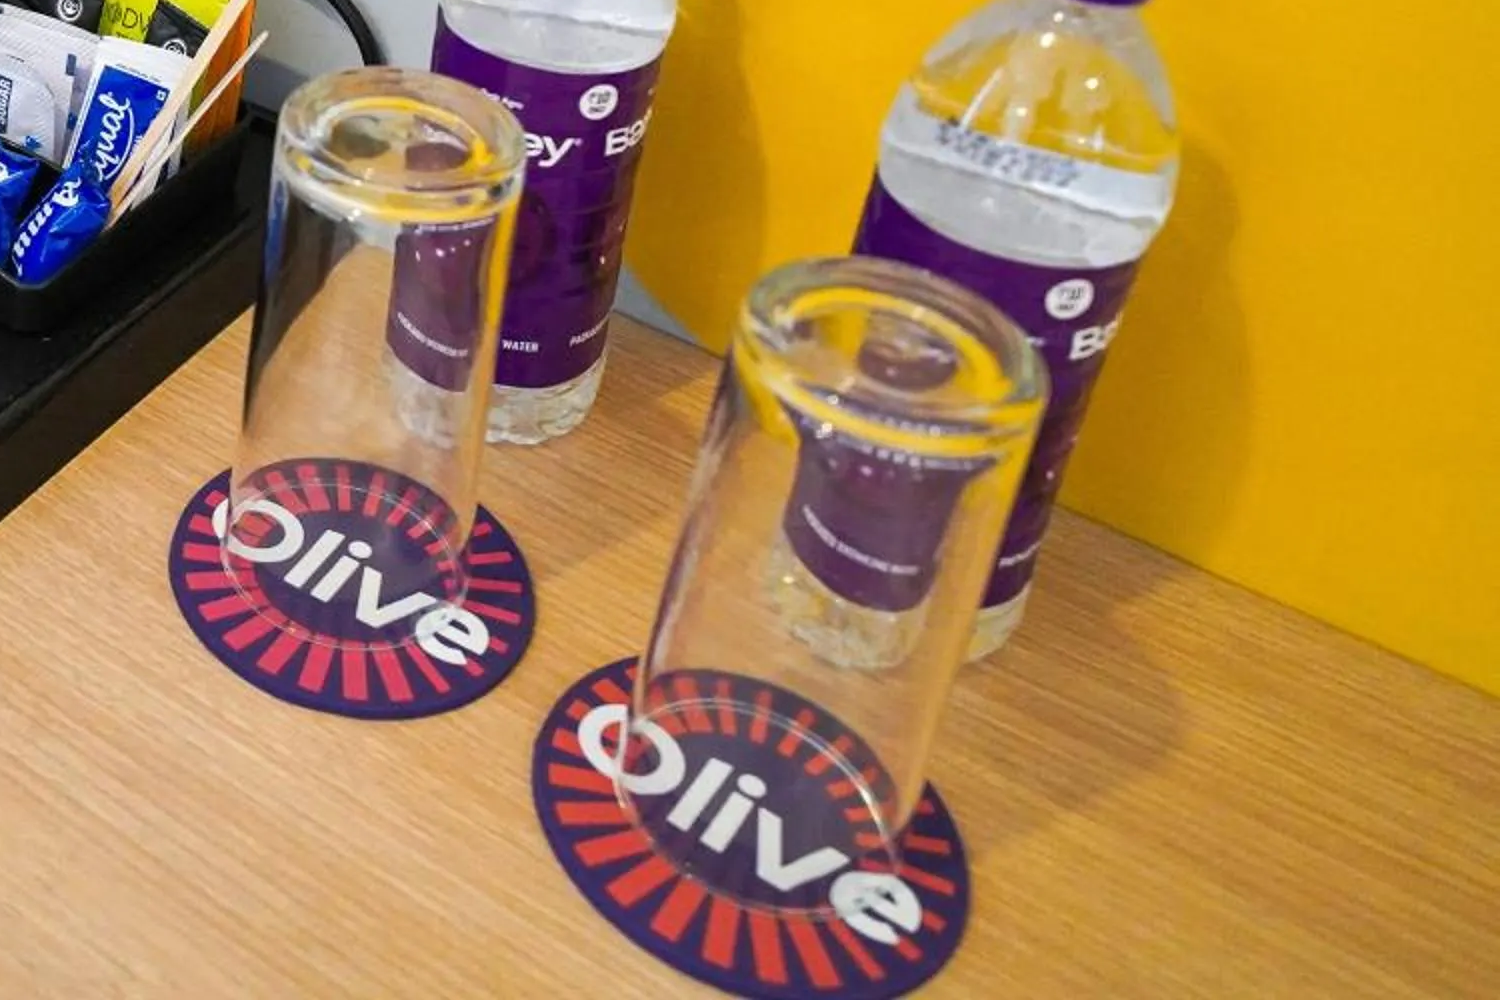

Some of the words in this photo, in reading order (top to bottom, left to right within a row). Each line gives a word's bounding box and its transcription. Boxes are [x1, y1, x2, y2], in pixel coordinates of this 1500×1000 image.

[95, 92, 131, 182] qual
[502, 339, 539, 353] WATER
[212, 497, 491, 666] Olive
[577, 703, 922, 945] Olive
